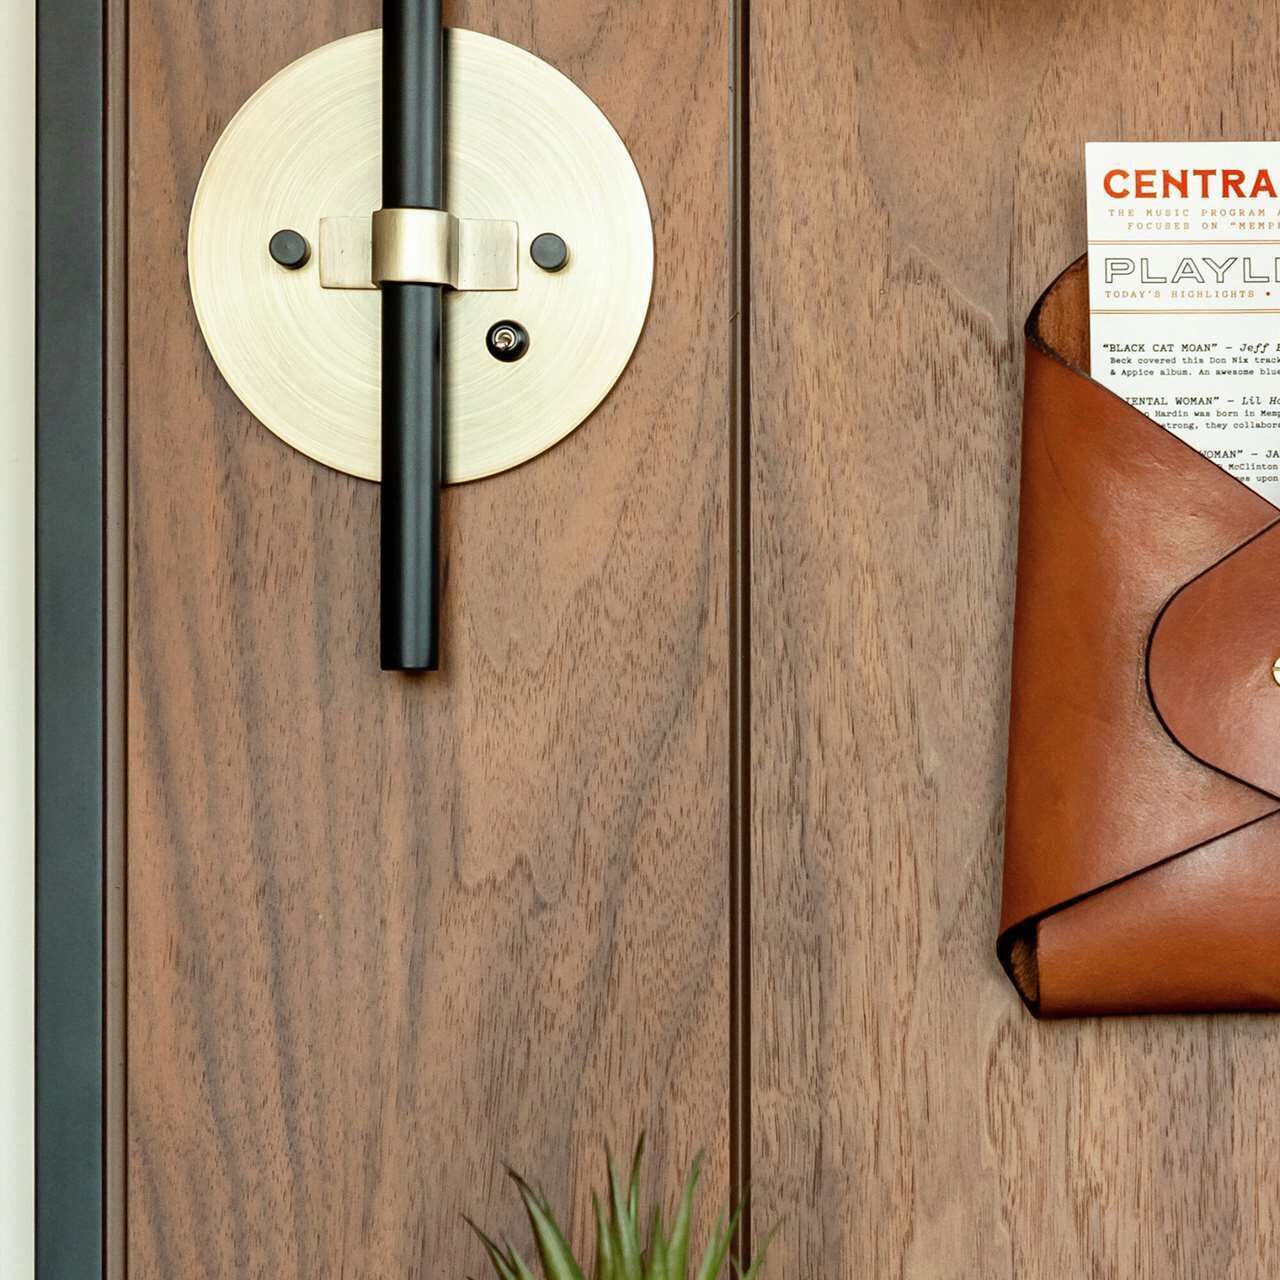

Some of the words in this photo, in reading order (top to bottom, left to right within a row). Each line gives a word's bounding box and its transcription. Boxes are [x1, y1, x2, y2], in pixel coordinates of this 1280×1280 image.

[1108, 208, 1134, 217] THE
[1146, 208, 1189, 217] MUSIC
[1201, 208, 1265, 217] PROGRAM
[1128, 221, 1189, 231] FOCUSES
[1202, 221, 1217, 230] ON
[1171, 289, 1254, 299] HIGHLIGHTS
[1103, 343, 1145, 353] “BLACK
[1153, 343, 1174, 353] CAT
[1182, 343, 1217, 353] MOAN”
[1240, 342, 1269, 354] Jeff
[1110, 356, 1132, 365] Beck
[1138, 356, 1176, 365] covered
[1182, 356, 1204, 365] this
[1210, 356, 1226, 365] Don
[1232, 355, 1248, 364] Nix
[1110, 368, 1116, 376] &
[1121, 368, 1154, 378] Appice
[1160, 367, 1191, 376] album.
[1199, 368, 1210, 376] An
[1176, 396, 1219, 406] WOMAN”
[1242, 395, 1261, 406] Lil
[1155, 409, 1189, 418] Hardin
[1216, 409, 1238, 418] born
[1245, 408, 1255, 417] in
[1206, 421, 1227, 431] they
[1228, 462, 1278, 471] McClinton
[1256, 475, 1279, 484] upon
